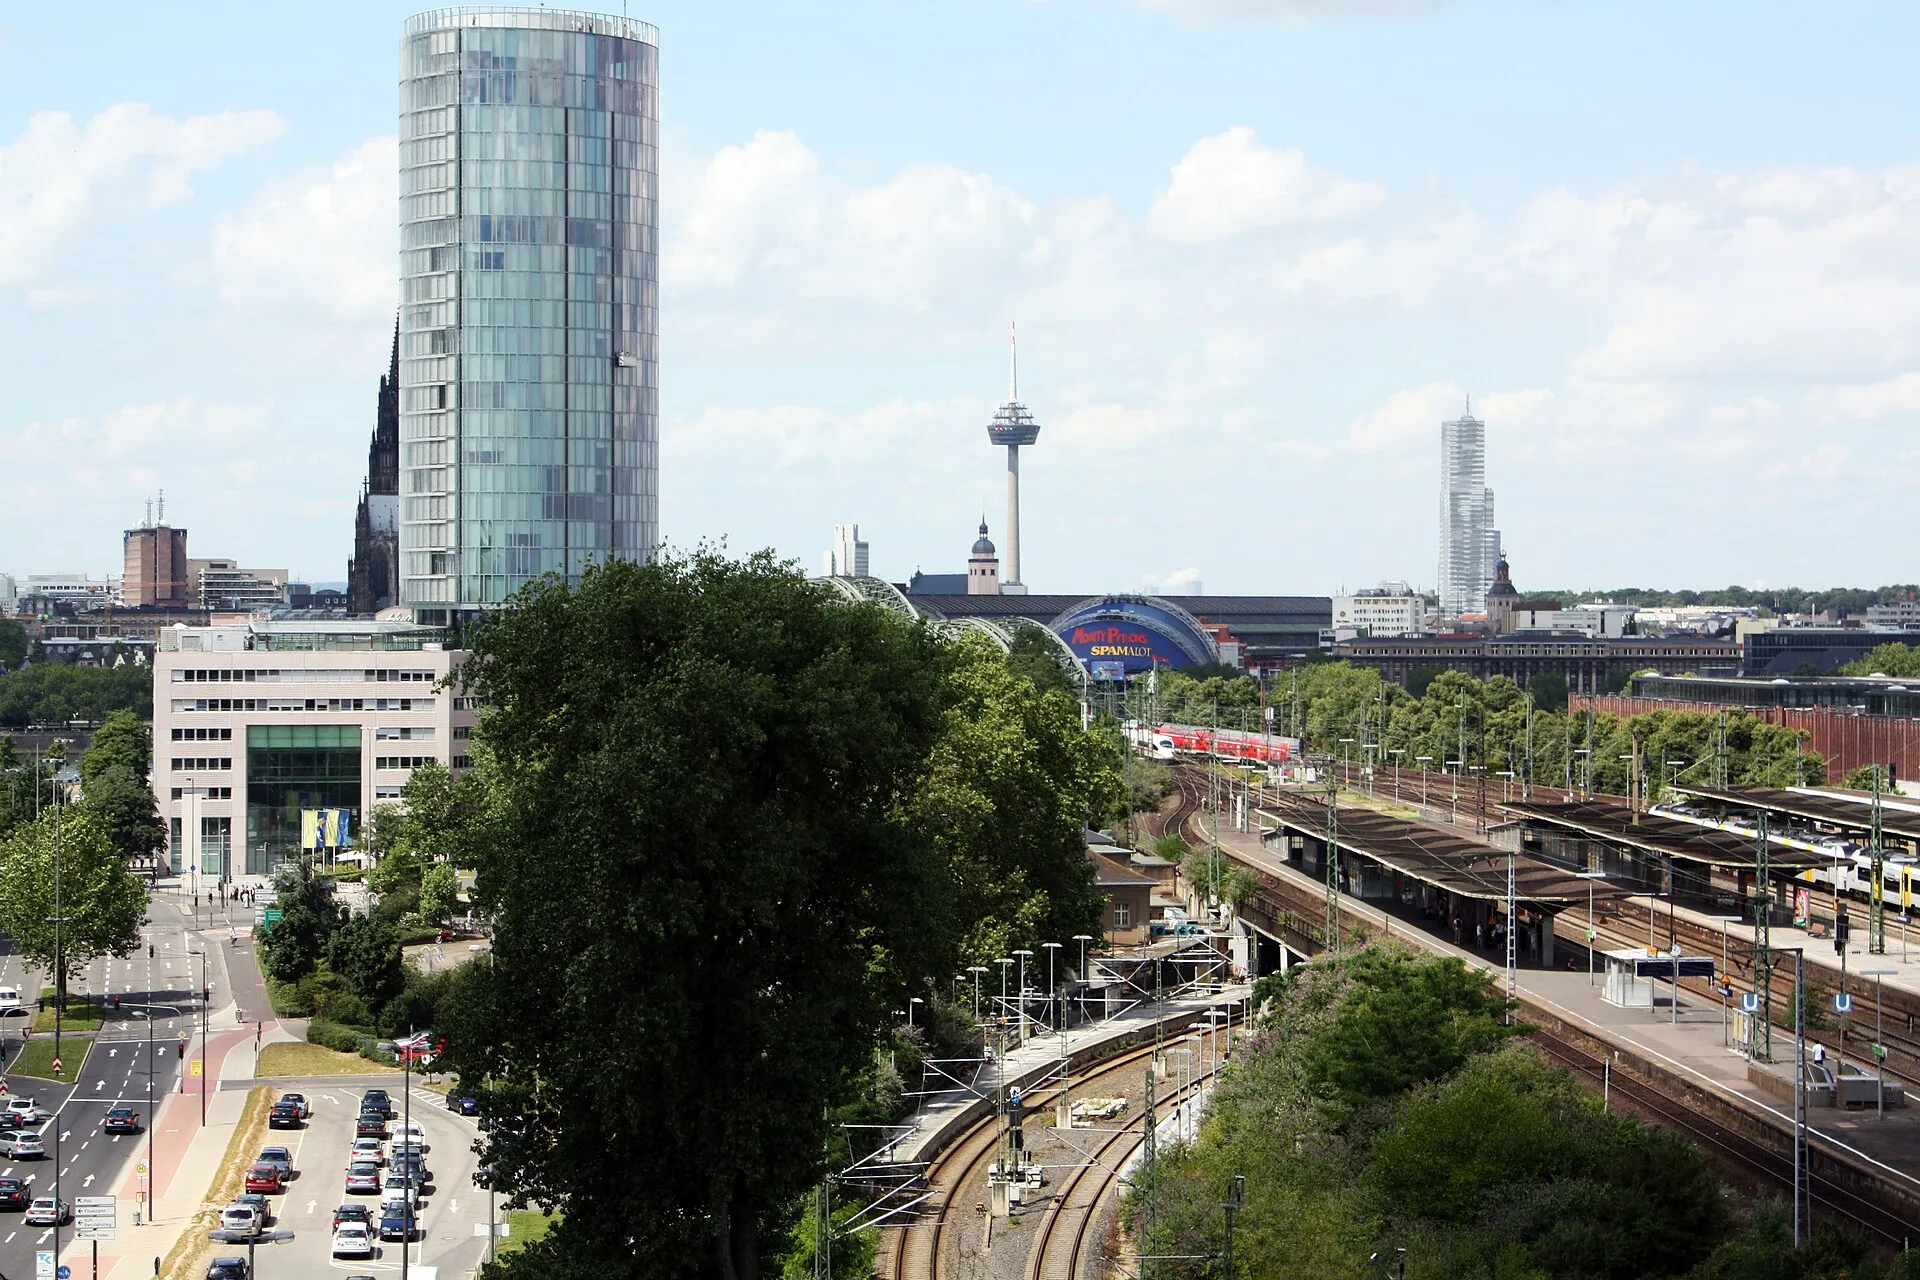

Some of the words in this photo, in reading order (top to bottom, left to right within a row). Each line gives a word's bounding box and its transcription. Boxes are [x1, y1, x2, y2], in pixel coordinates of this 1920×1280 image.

[1090, 645, 1152, 657] SPAMALOT
[1743, 994, 1758, 1010] U
[1836, 994, 1850, 1011] U
